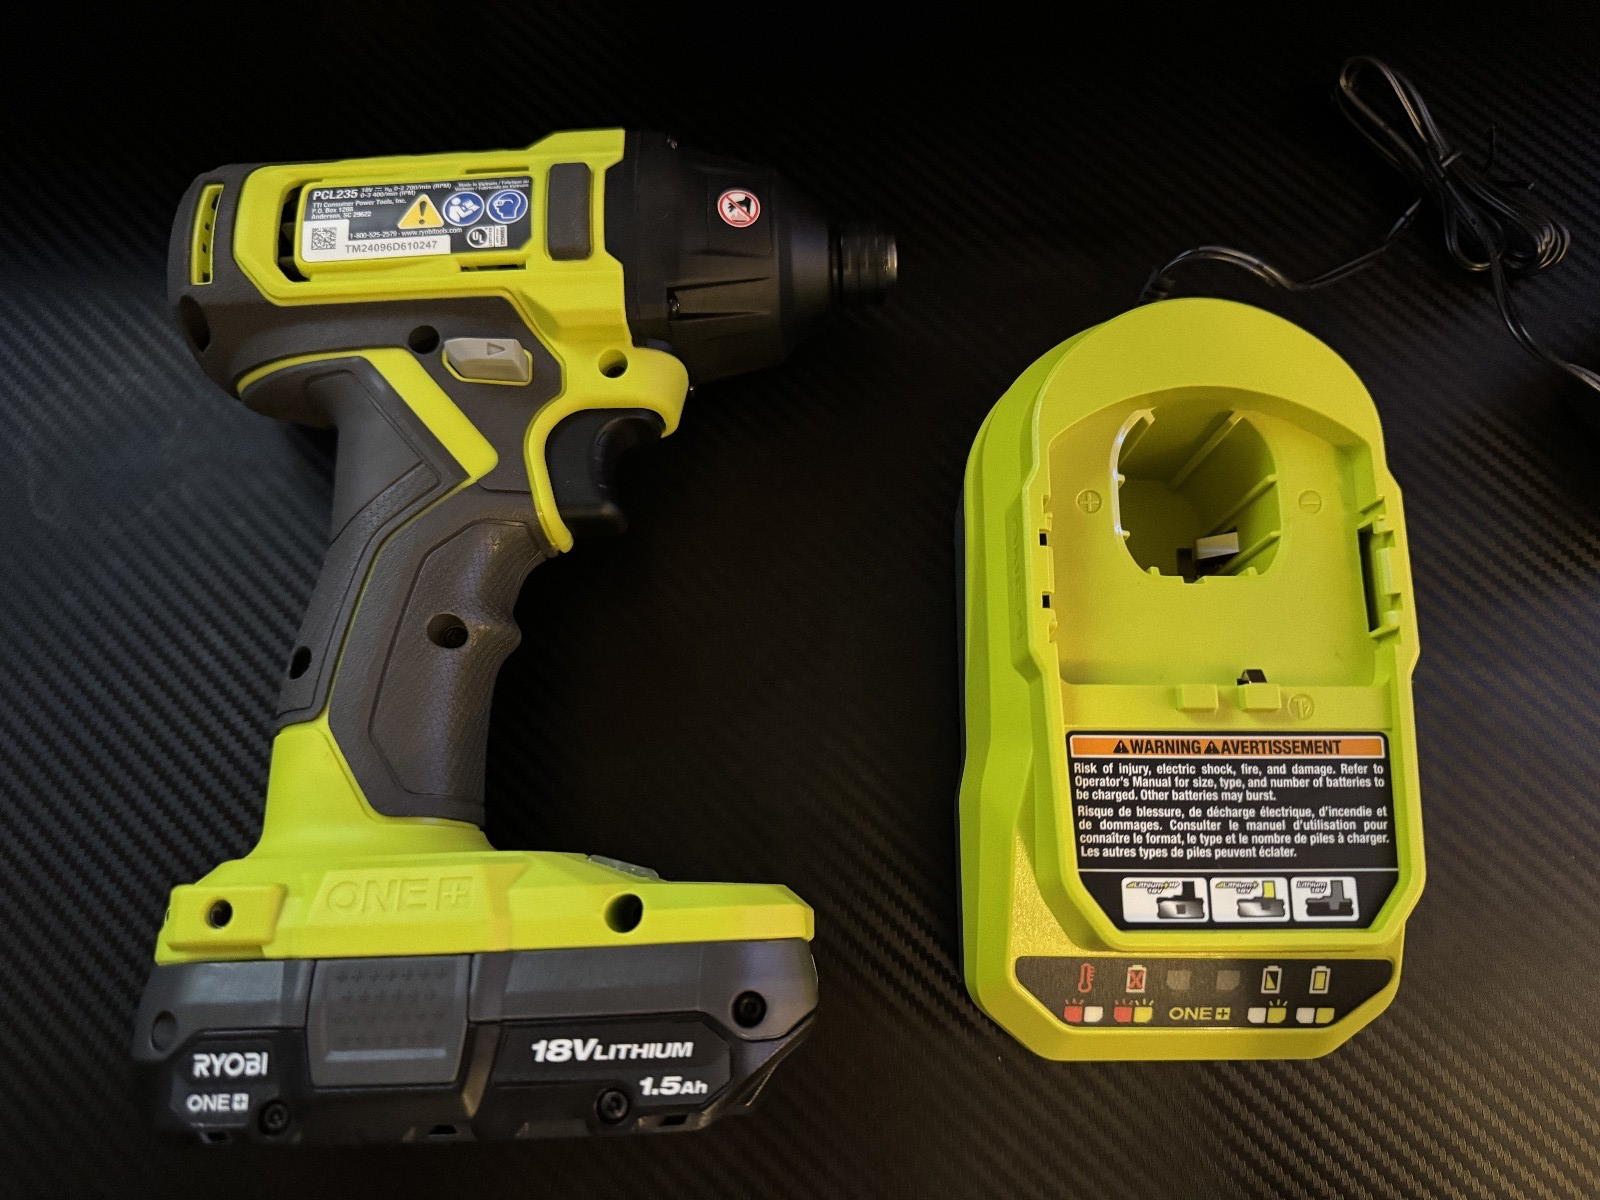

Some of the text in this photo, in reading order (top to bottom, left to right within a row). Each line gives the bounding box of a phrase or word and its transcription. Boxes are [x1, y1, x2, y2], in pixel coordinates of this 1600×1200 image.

[313, 189, 358, 200] PCL235
[350, 227, 462, 239] 1-800-525-2579 www.ryobitools.com
[472, 231, 484, 243] UL
[345, 241, 438, 253] TM24096D610247
[1130, 740, 1341, 754] WARNING AVERTISSEMENT
[1074, 762, 1384, 776] Risk of injury, electric shock, fire, and damage. Refer to
[1075, 776, 1385, 790] Operator's Manual for size, type, and number of batteries to
[1076, 789, 1277, 803] be charged. Other batteries may burst.
[1077, 805, 1387, 819] Risque de blessure, de décharge électrique, d'incendie et
[1079, 819, 1388, 832] de dommages. Consulter le manuel d'utilisation pour
[1080, 832, 1389, 846] connaître le format, le type et le nombre de piles à charger.
[1081, 846, 1297, 860] Les autres types de piles peuvent éclater.
[192, 1052, 268, 1078] RYOBI
[638, 1076, 708, 1097] 1.5Ah
